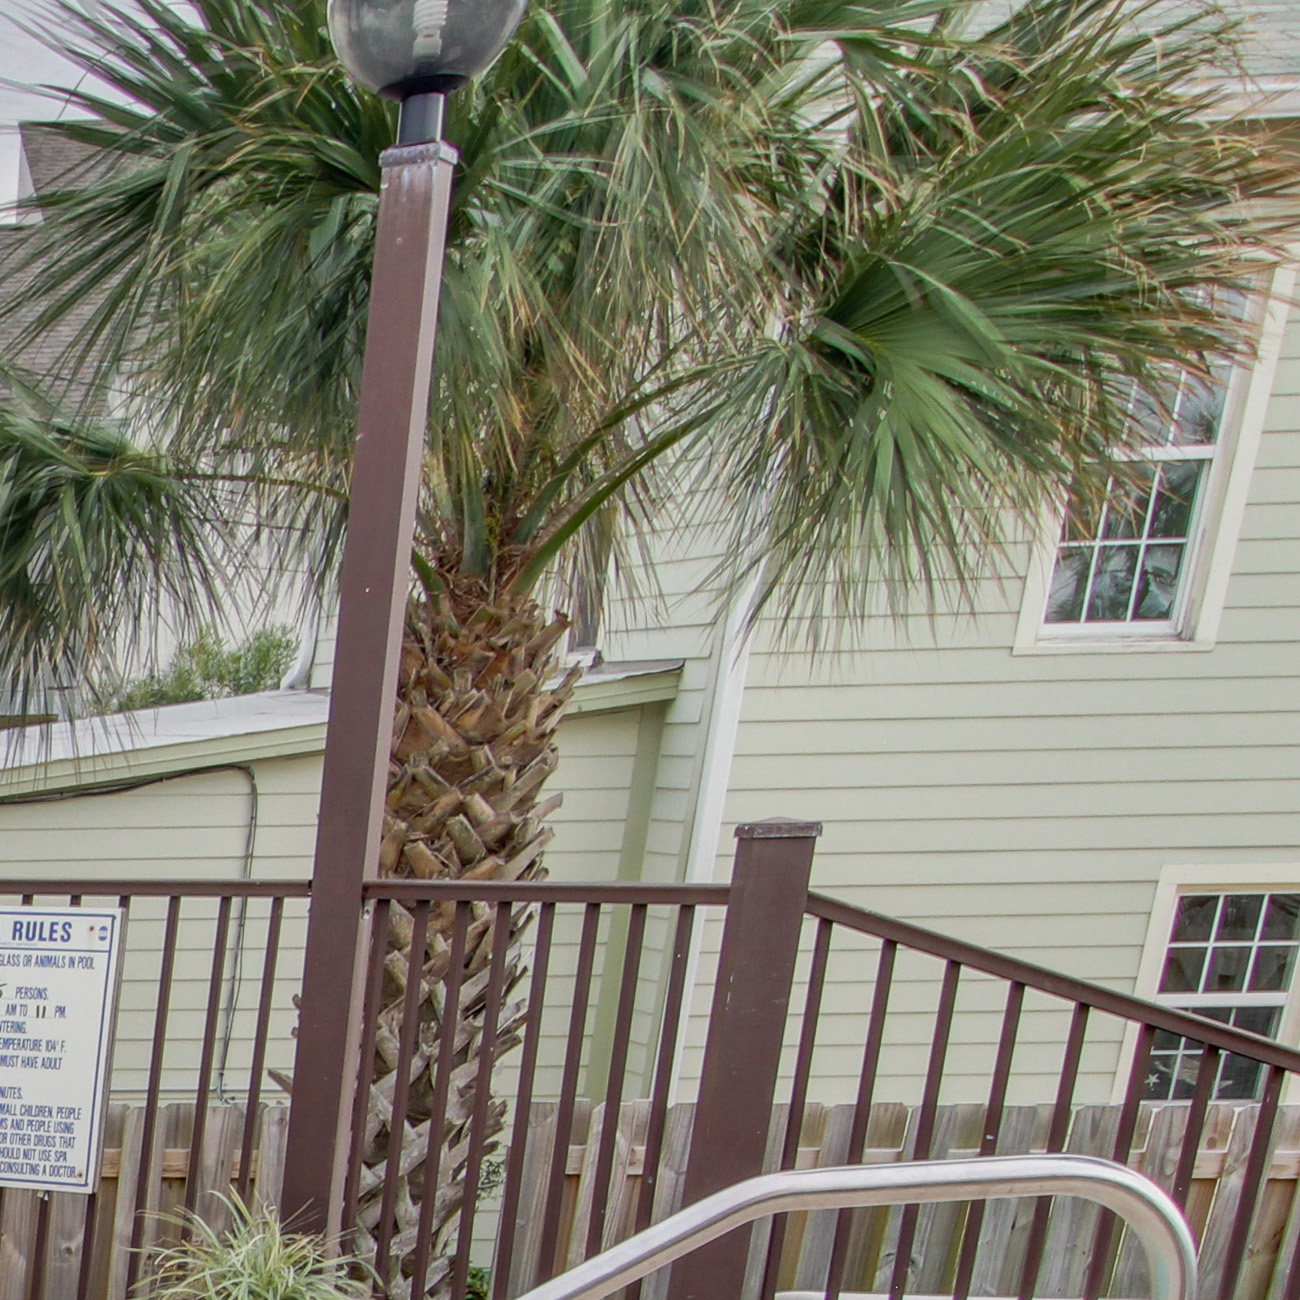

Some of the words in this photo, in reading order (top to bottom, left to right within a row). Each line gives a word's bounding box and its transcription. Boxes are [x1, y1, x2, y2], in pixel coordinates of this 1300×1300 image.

[12, 921, 72, 942] RULES
[23, 955, 32, 967] OR
[34, 955, 66, 968] ANIMALS
[68, 956, 75, 968] IN
[77, 957, 95, 969] POOL
[15, 987, 48, 1000] PERSONS.
[5, 1004, 17, 1015] AM
[20, 1004, 28, 1016] TO
[36, 1005, 46, 1018] 11
[0, 1055, 19, 1067] MUST
[21, 1056, 39, 1068] HAVE
[41, 1057, 63, 1070] ADULT
[56, 1107, 82, 1120] PEOPLE
[10, 1118, 24, 1131] AND
[26, 1120, 52, 1133] PEOPLE
[54, 1121, 74, 1134] USING
[0, 1133, 8, 1144] OR
[10, 1133, 31, 1146] OTHER
[34, 1135, 56, 1148] DRUGS
[59, 1137, 76, 1148] THAT
[23, 1148, 37, 1160] NOT
[38, 1150, 52, 1162] USE
[54, 1151, 67, 1163] SPA
[0, 1161, 40, 1175] CONSULTING
[42, 1165, 47, 1176] A
